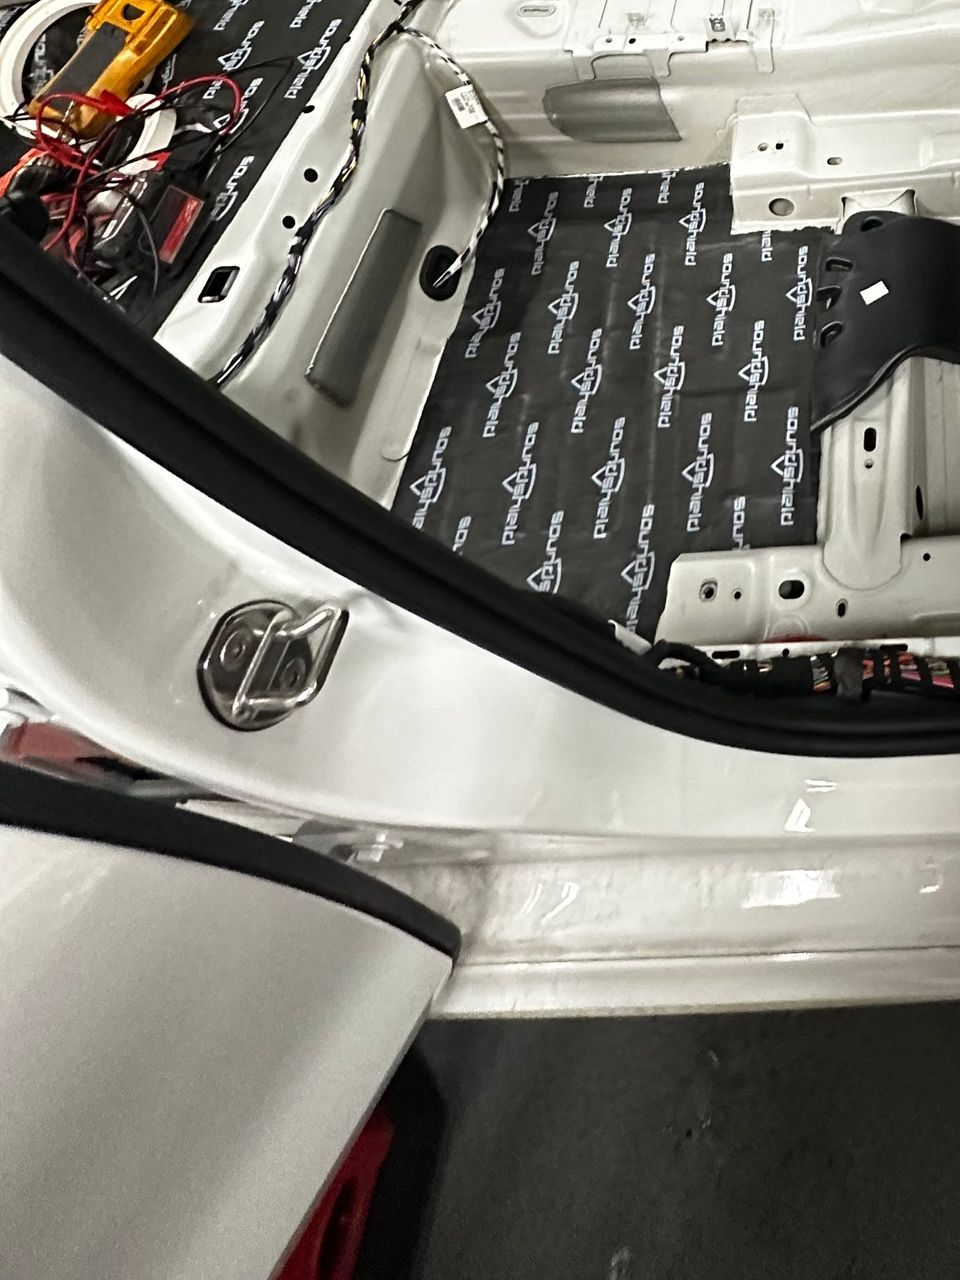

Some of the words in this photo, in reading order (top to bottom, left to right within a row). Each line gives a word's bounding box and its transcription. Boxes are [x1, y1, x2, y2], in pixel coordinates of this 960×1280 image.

[531, 191, 558, 275] soundshield
[606, 187, 632, 267] soundshield
[685, 181, 704, 266] soundshield
[465, 268, 505, 358] soundshield
[548, 261, 579, 354] soundshield
[629, 253, 655, 350] soundshield
[711, 253, 733, 346] soundshield
[793, 245, 809, 341] soundshield
[483, 332, 521, 437] soundshield
[571, 328, 602, 433] soundshield
[658, 325, 684, 428] soundshield
[744, 320, 765, 422] soundshield
[412, 426, 452, 530] soundshie
[502, 422, 539, 545] soundshield
[593, 417, 625, 539] soundshield
[687, 413, 712, 532] soundshield
[780, 406, 799, 526] soundshield
